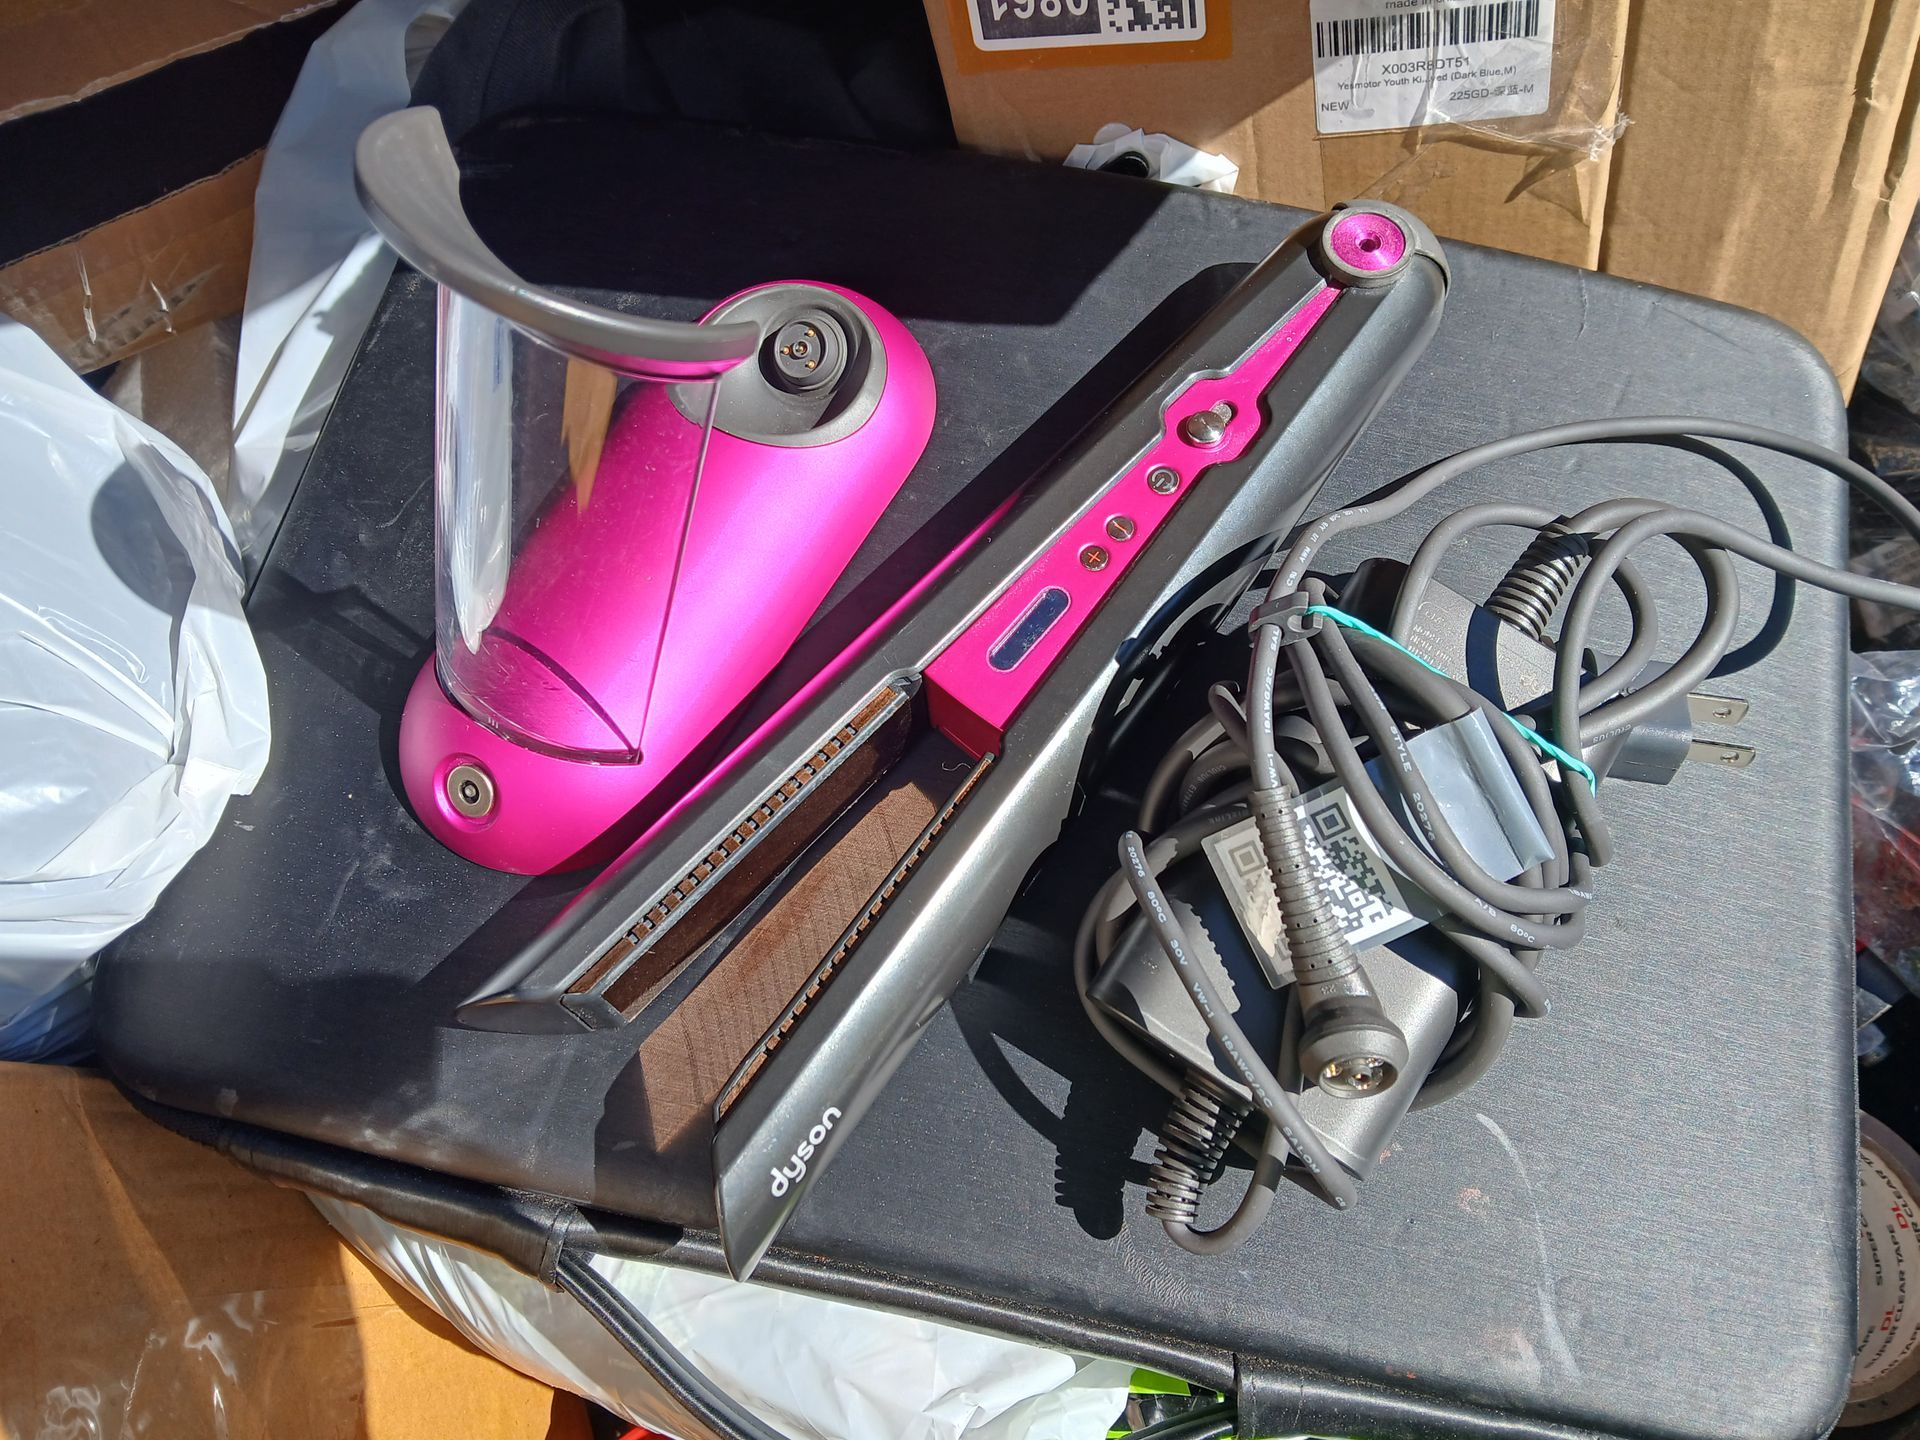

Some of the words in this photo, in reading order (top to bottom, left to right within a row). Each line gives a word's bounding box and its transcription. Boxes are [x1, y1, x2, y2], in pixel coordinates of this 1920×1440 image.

[1383, 77, 1410, 87] Youth
[1450, 70, 1477, 81] (Dark
[1321, 101, 1349, 112] NEW
[1191, 982, 1215, 1019] VW-1
[770, 1106, 842, 1197] dyson
[1890, 1201, 1909, 1230] DL
[1866, 1232, 1883, 1287] SUPER
[1886, 1223, 1904, 1267] TAPE
[1894, 1270, 1906, 1323] CLEAR
[1880, 1304, 1896, 1332] DL
